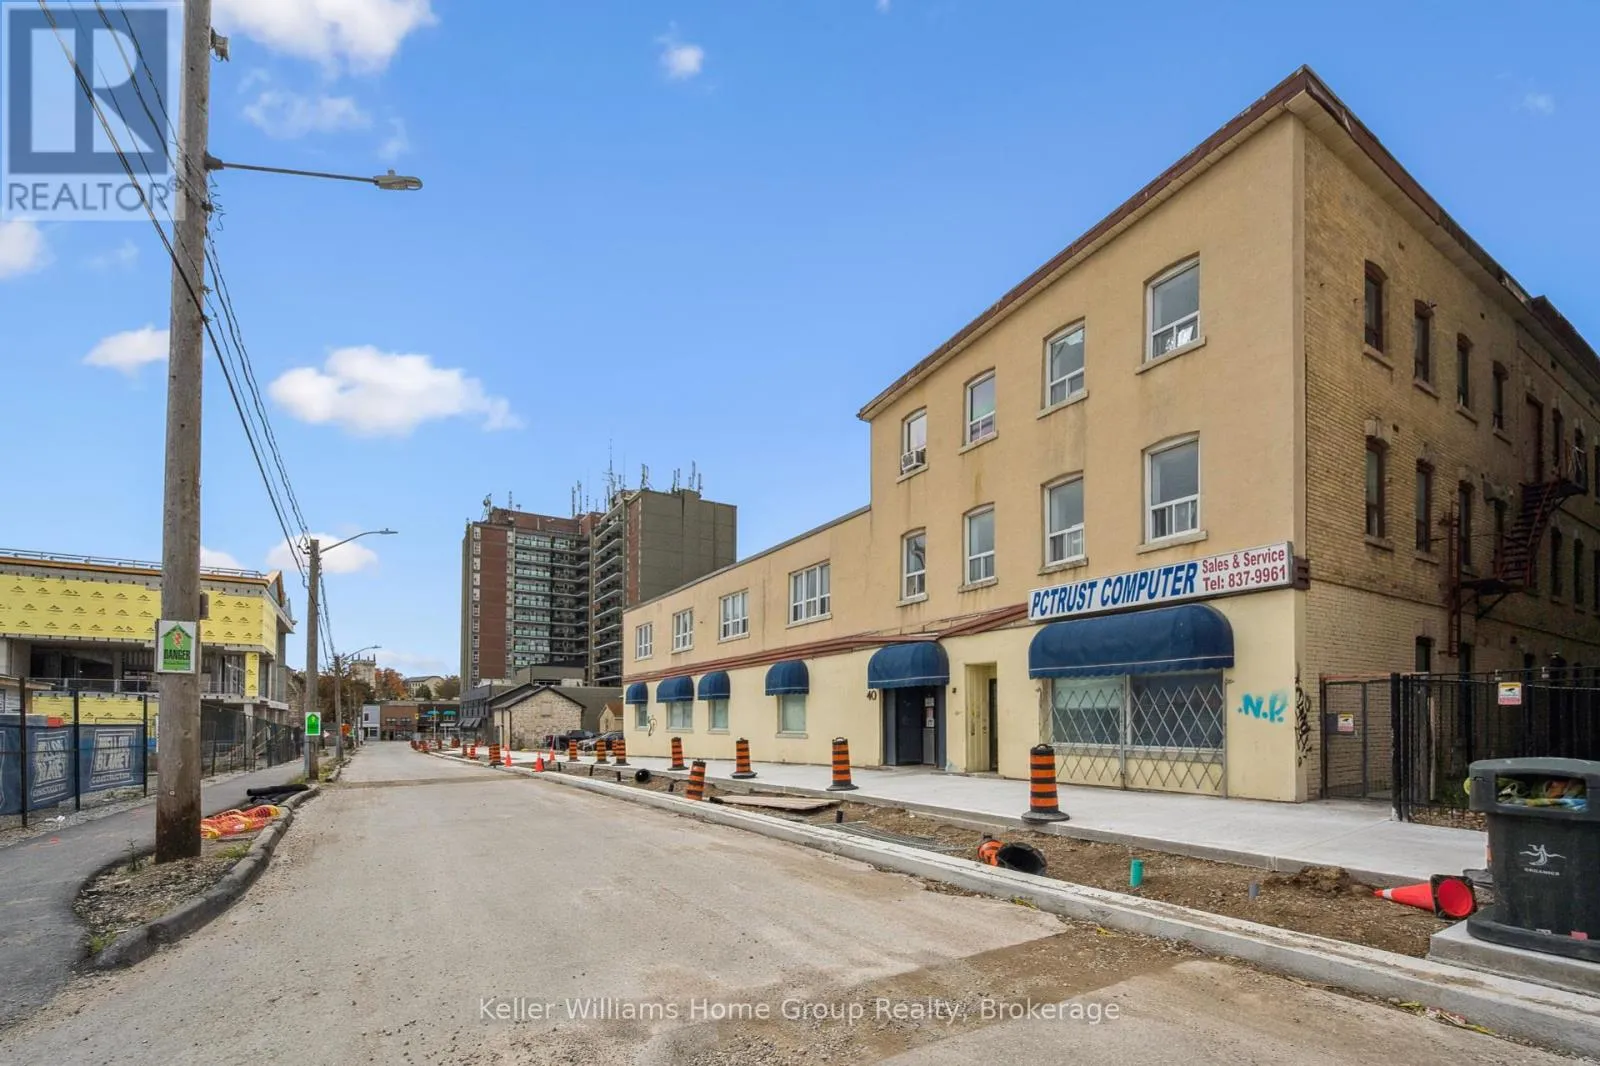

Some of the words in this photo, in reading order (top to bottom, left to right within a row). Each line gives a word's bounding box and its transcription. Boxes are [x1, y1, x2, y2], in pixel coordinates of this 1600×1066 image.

[1202, 558, 1229, 574] Sales
[1233, 554, 1241, 569] &
[1244, 548, 1285, 567] Service
[1031, 581, 1098, 617] PCTRUST
[1101, 562, 1199, 606] COMPUTER
[1203, 576, 1225, 591] Tel:
[1228, 565, 1286, 588] 837-9961
[866, 690, 877, 700] 40
